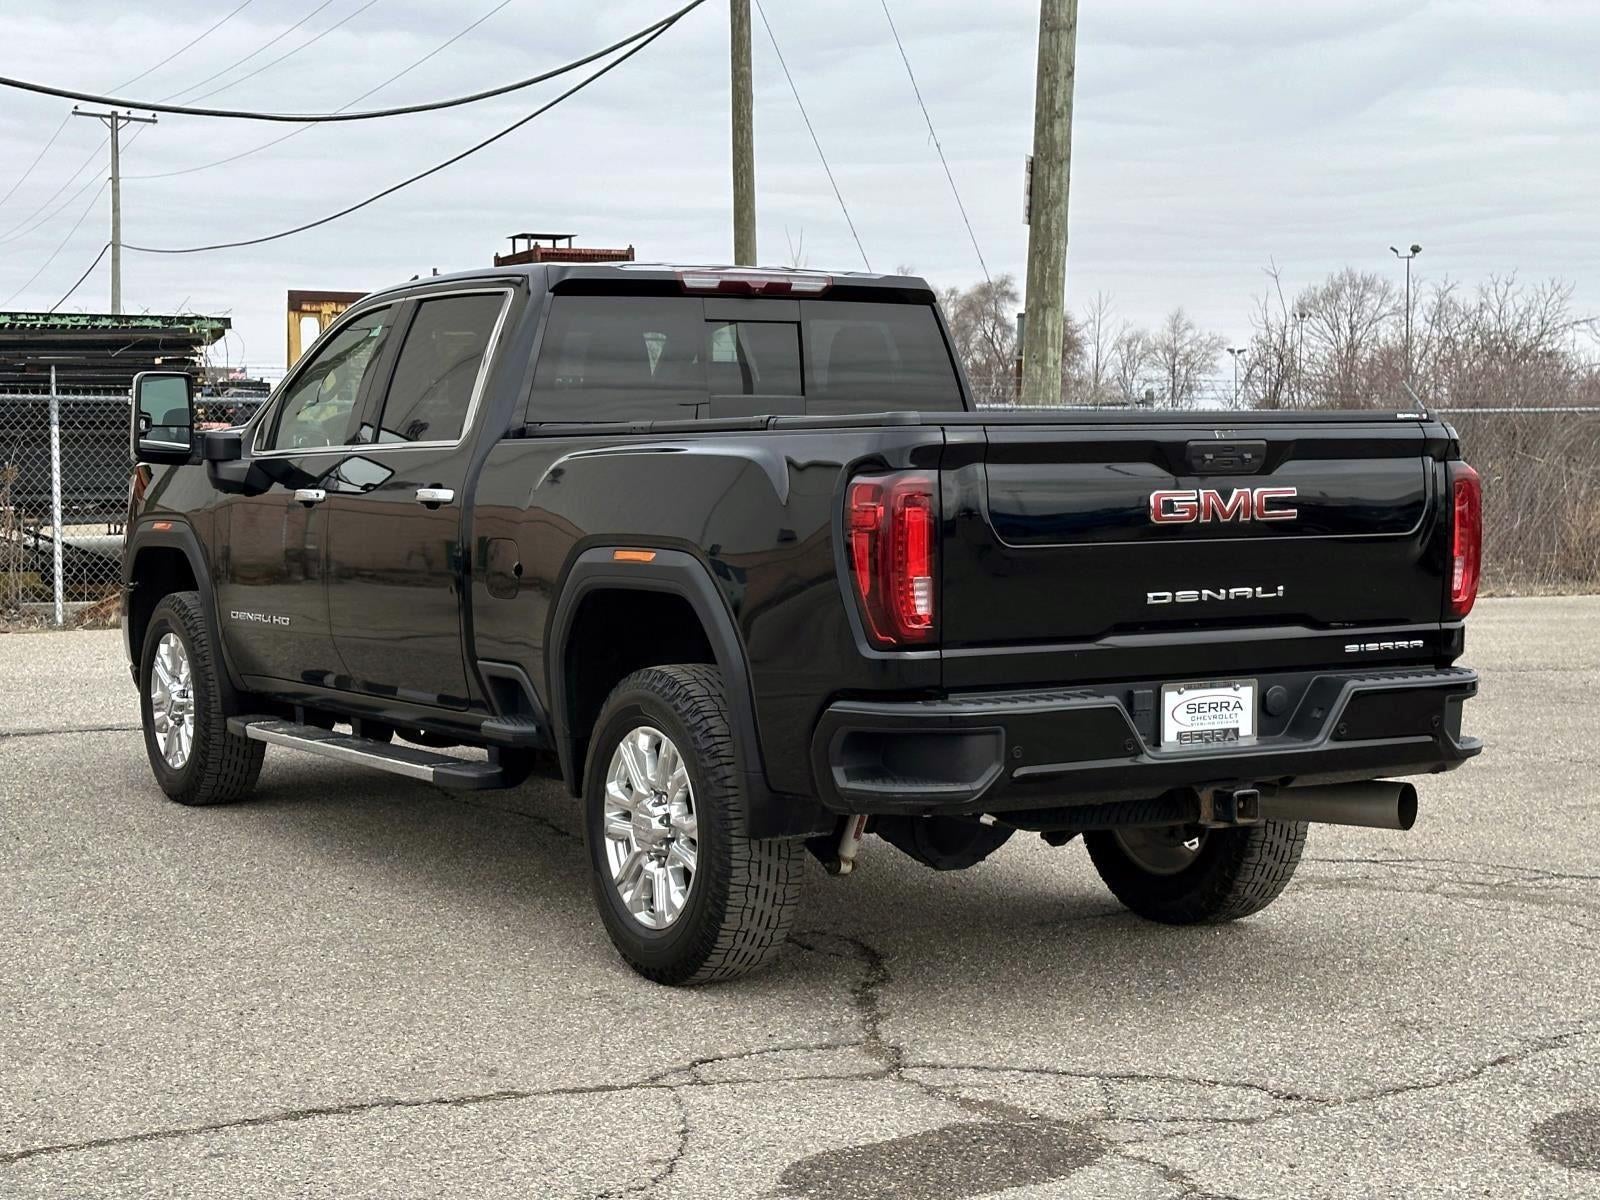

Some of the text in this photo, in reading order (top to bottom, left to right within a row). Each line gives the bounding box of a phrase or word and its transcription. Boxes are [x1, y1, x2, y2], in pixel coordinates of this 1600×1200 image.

[1150, 487, 1298, 524] GMC
[1146, 585, 1284, 605] DENALI
[230, 610, 290, 626] DENALI HD
[1344, 639, 1424, 653] SIERRA
[1186, 700, 1244, 715] SERRA
[1190, 712, 1239, 722] CHEVROLET
[1180, 728, 1238, 744] SERRA
